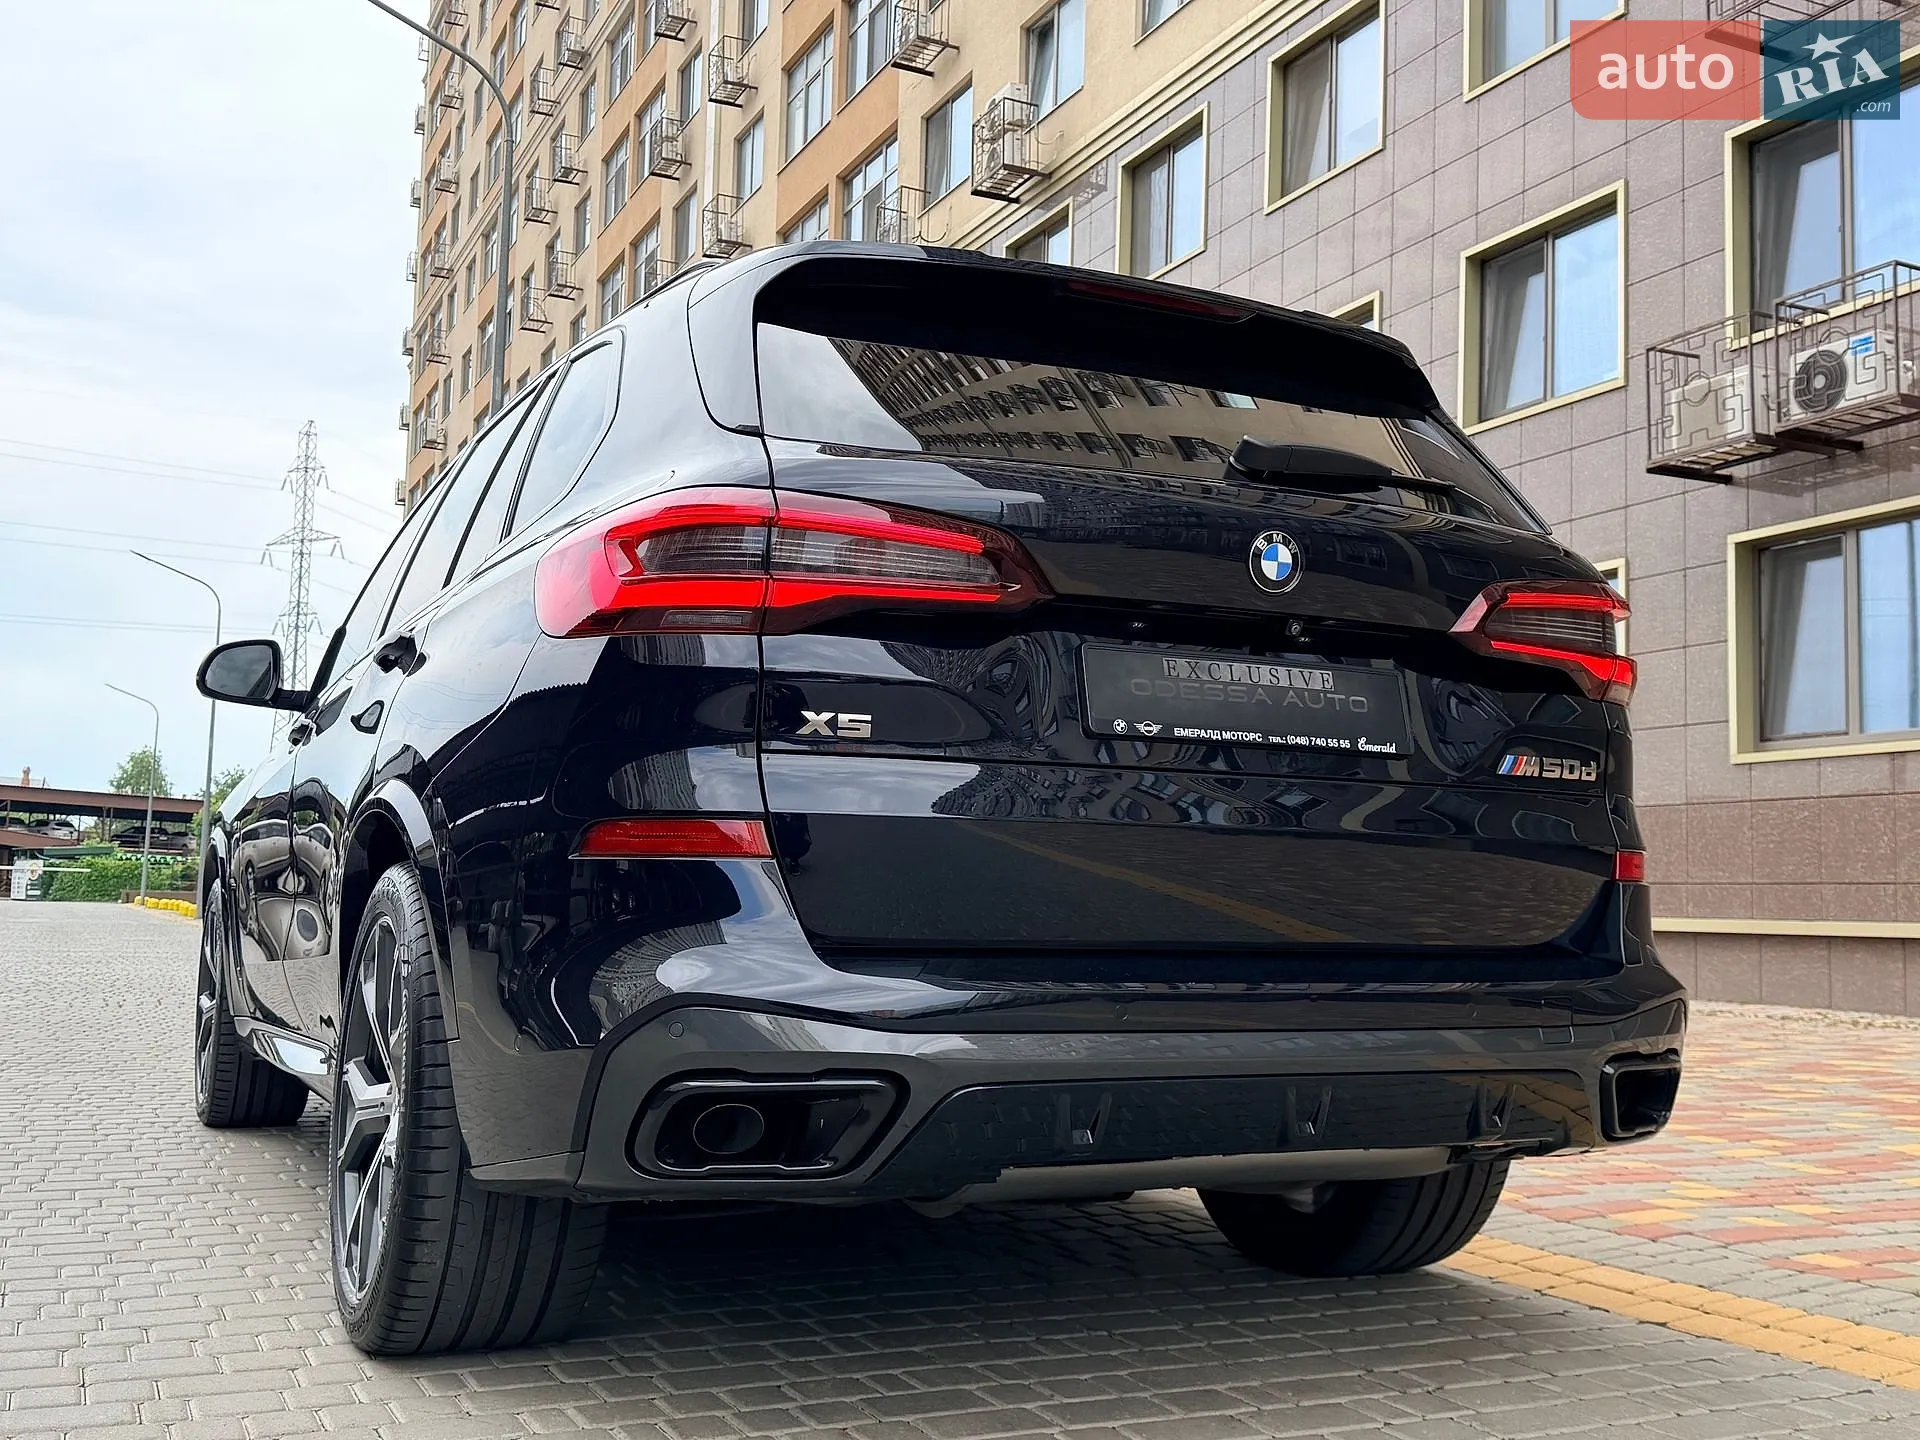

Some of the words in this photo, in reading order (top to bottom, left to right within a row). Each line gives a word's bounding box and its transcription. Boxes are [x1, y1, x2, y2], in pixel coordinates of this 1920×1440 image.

[1256, 533, 1298, 554] BMW
[1166, 658, 1334, 691] EXCLUSIVE
[1130, 678, 1272, 705] ODESSA
[1283, 688, 1368, 713] AUTO
[795, 710, 872, 738] X5
[1173, 727, 1222, 741] ЕМЕРАЛД
[1222, 730, 1263, 742] МОТОРС
[1287, 734, 1309, 746] (048)
[1310, 737, 1327, 747] 740
[1327, 738, 1339, 748] 55
[1339, 739, 1351, 748] 55
[1357, 737, 1397, 753] Emerald
